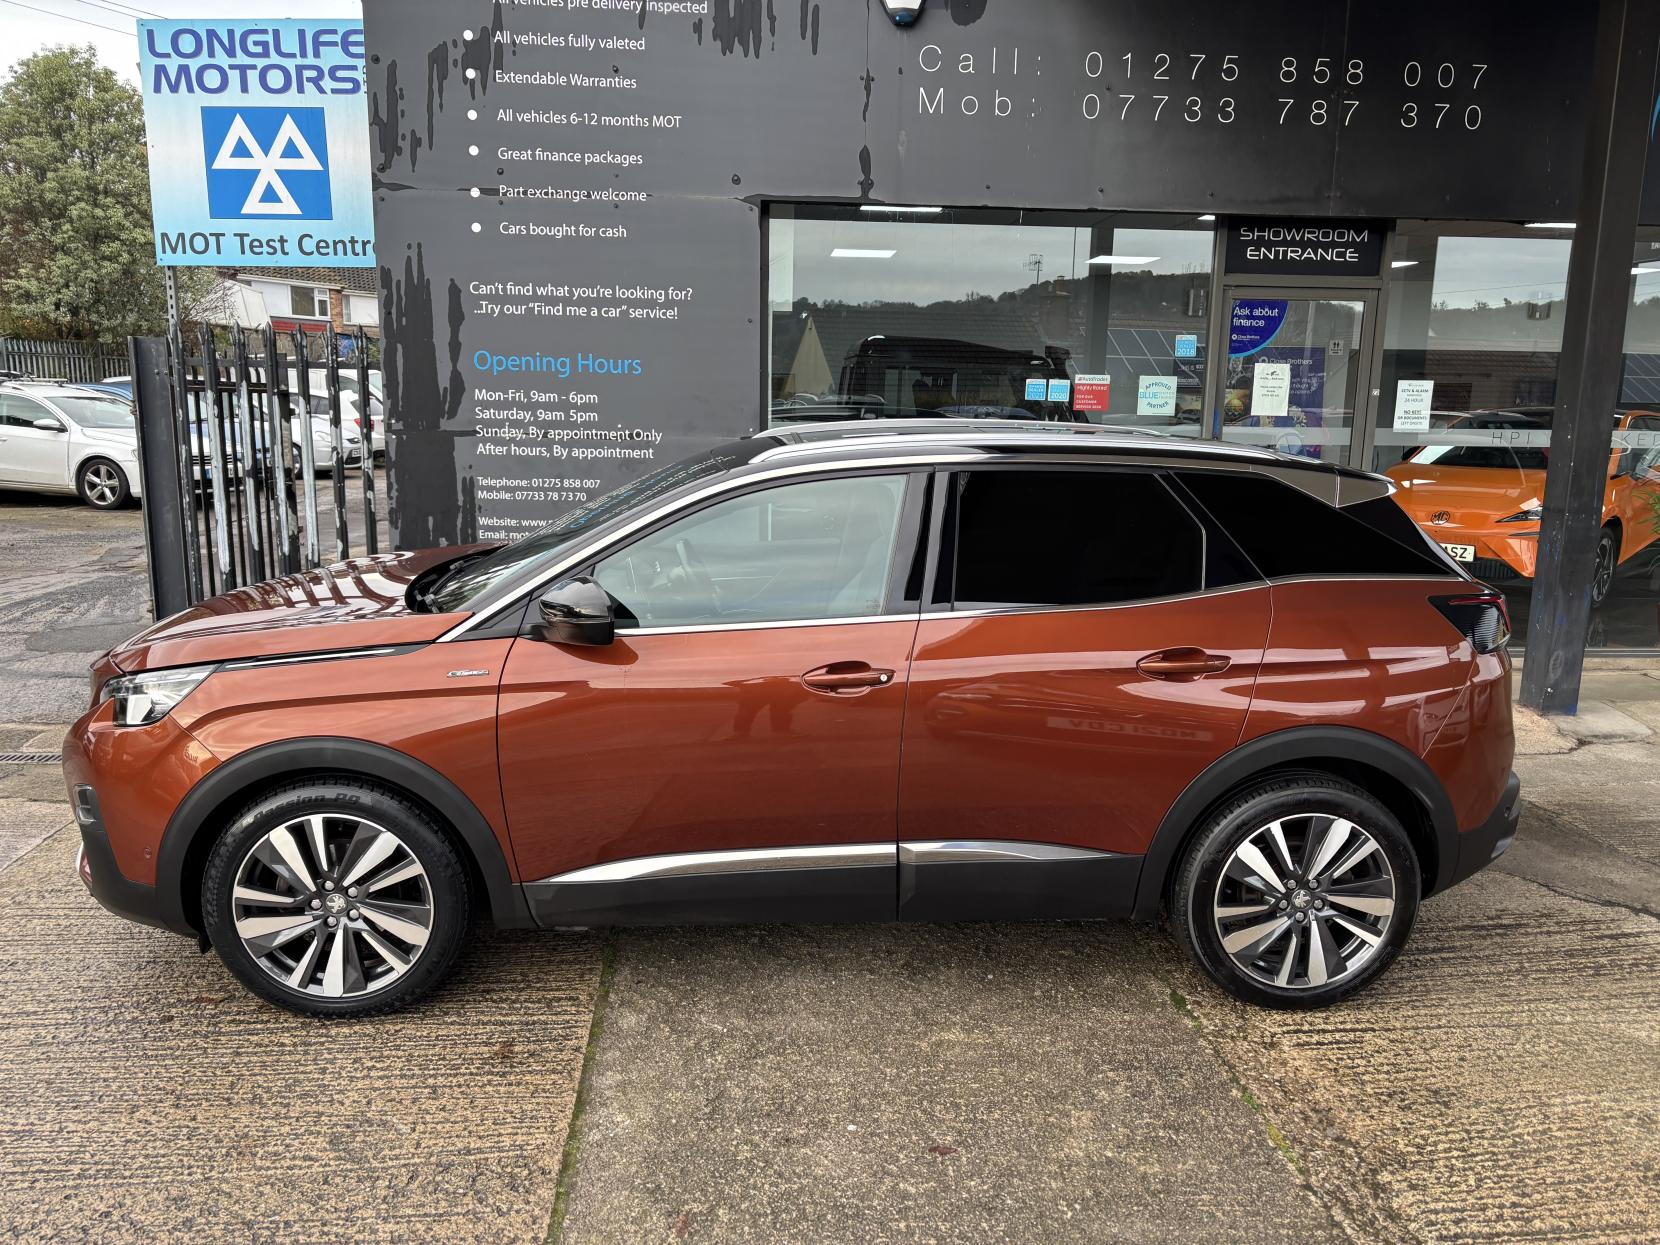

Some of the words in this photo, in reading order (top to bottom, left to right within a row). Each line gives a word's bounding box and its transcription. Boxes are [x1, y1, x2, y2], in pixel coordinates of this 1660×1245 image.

[646, 0, 708, 14] inspected
[146, 28, 364, 60] LONGLIFE
[494, 31, 510, 44] All
[514, 32, 565, 46] vehicles
[568, 34, 596, 50] fully
[599, 36, 645, 50] valeted
[919, 45, 1041, 75] Call:
[1086, 51, 1239, 81] 01275
[1279, 56, 1364, 85] 858
[1404, 61, 1487, 89] 007
[152, 64, 361, 95] MOTORS
[496, 70, 566, 86] Extendable
[570, 74, 636, 88] Warranties
[919, 88, 1035, 118] Mob:
[1082, 94, 1235, 122] 07733
[1278, 98, 1359, 126] 787
[1400, 102, 1482, 130] 370
[497, 109, 512, 122] All
[516, 110, 566, 124] vehicles
[570, 113, 598, 125] 6-12
[602, 114, 649, 127] months
[652, 116, 682, 128] MOT
[498, 148, 532, 161] Great
[536, 149, 581, 162] finance
[584, 151, 642, 166] packages
[500, 185, 524, 198] Part
[528, 187, 589, 202] exchange
[590, 188, 646, 201] welcome
[500, 222, 526, 234] Cars
[530, 223, 576, 238] bought
[578, 224, 596, 236] for
[599, 225, 627, 238] cash
[1240, 227, 1368, 244] SHOWROOM
[160, 232, 226, 254] MOT
[234, 233, 289, 256] Test
[1246, 246, 1360, 262] ENTRANCE
[506, 282, 532, 296] find
[536, 284, 570, 297] what
[616, 286, 664, 302] looking
[668, 288, 692, 300] for?
[504, 304, 526, 314] our
[566, 306, 587, 316] me
[590, 308, 598, 316] a
[629, 306, 678, 319] service!
[1234, 306, 1250, 316] Ask
[1253, 306, 1278, 316] about
[1233, 318, 1264, 326] finance
[474, 350, 570, 377] Opening
[577, 353, 642, 375] Hours
[1144, 382, 1172, 390] APPROVED
[474, 389, 527, 404] Mon-Fri,
[530, 391, 558, 402] 9am
[569, 391, 598, 404] 6pm
[1147, 400, 1169, 408] PARTNER
[475, 407, 534, 422] Saturday,
[537, 410, 564, 420] 9am
[570, 410, 598, 422] 5pm
[476, 425, 525, 440] Sunday,
[529, 426, 544, 440] By
[548, 428, 630, 442] appointment
[633, 429, 662, 443] Only
[1492, 432, 1530, 445] HPI
[476, 444, 508, 455] After
[511, 444, 550, 458] hours,
[554, 445, 568, 458] By
[572, 446, 654, 460] appointment
[477, 477, 530, 488] Telephone:
[532, 478, 561, 487] 01275
[564, 479, 581, 488] 858
[583, 480, 600, 488] 007
[478, 491, 513, 500] Mobile:
[516, 492, 544, 500] 07733
[479, 517, 519, 526] Website:
[480, 530, 508, 540] Email:
